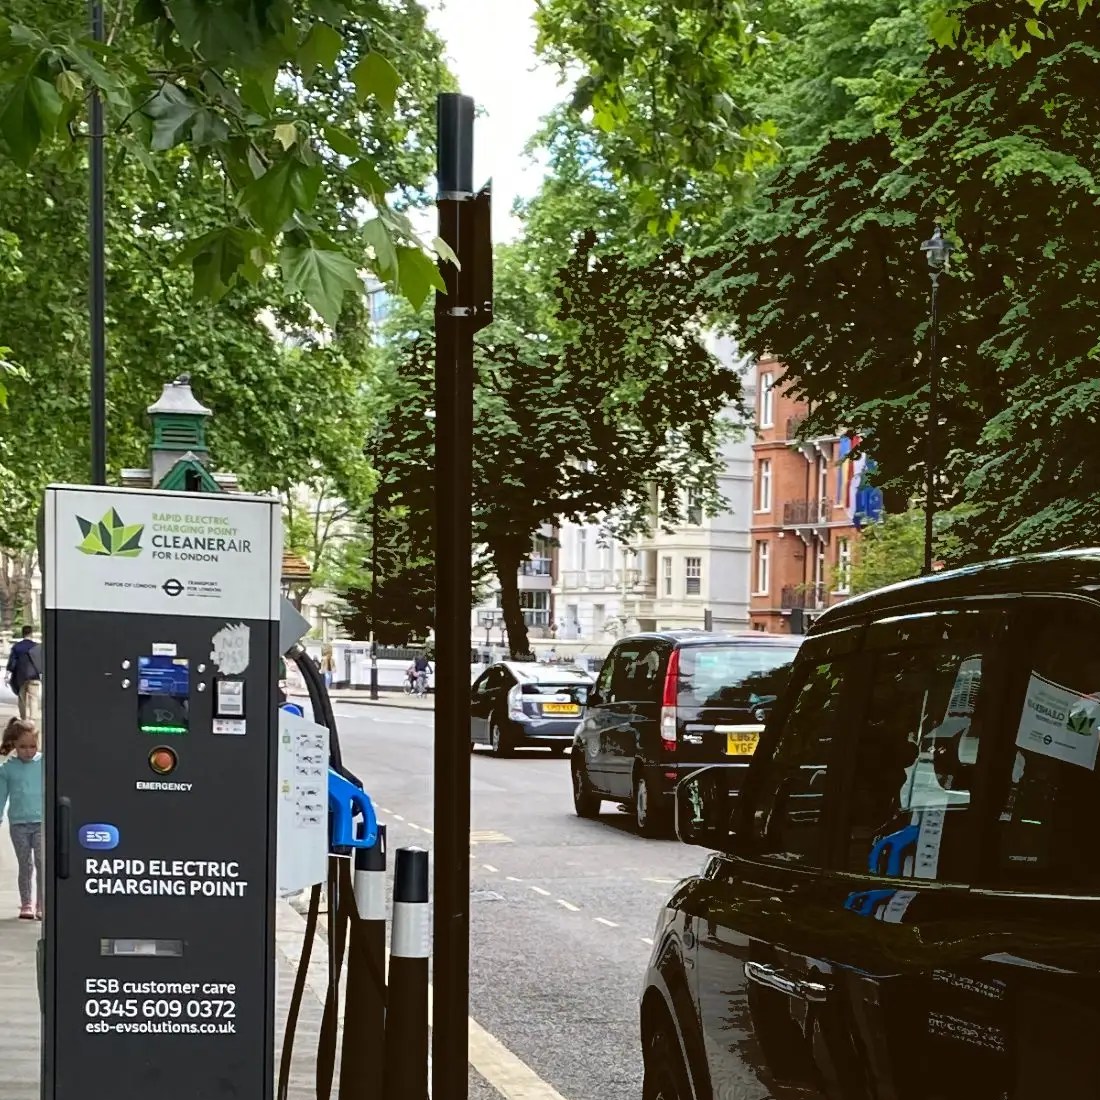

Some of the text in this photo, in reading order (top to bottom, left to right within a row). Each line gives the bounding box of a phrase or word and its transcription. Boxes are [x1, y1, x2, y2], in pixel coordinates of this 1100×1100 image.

[152, 512, 229, 525] RAPID ELECTRIC
[152, 523, 238, 536] CHARGING POINT
[152, 551, 219, 562] FOR LONDON
[136, 781, 193, 791] EMERGENCY
[86, 858, 239, 877] RAPID ELECTRIC
[85, 878, 248, 897] CHARGING POINT
[85, 978, 236, 994] ESB customer care
[85, 999, 236, 1018] 0345 609 0372
[85, 1020, 236, 1034] esb-evsolutions.co.uk
